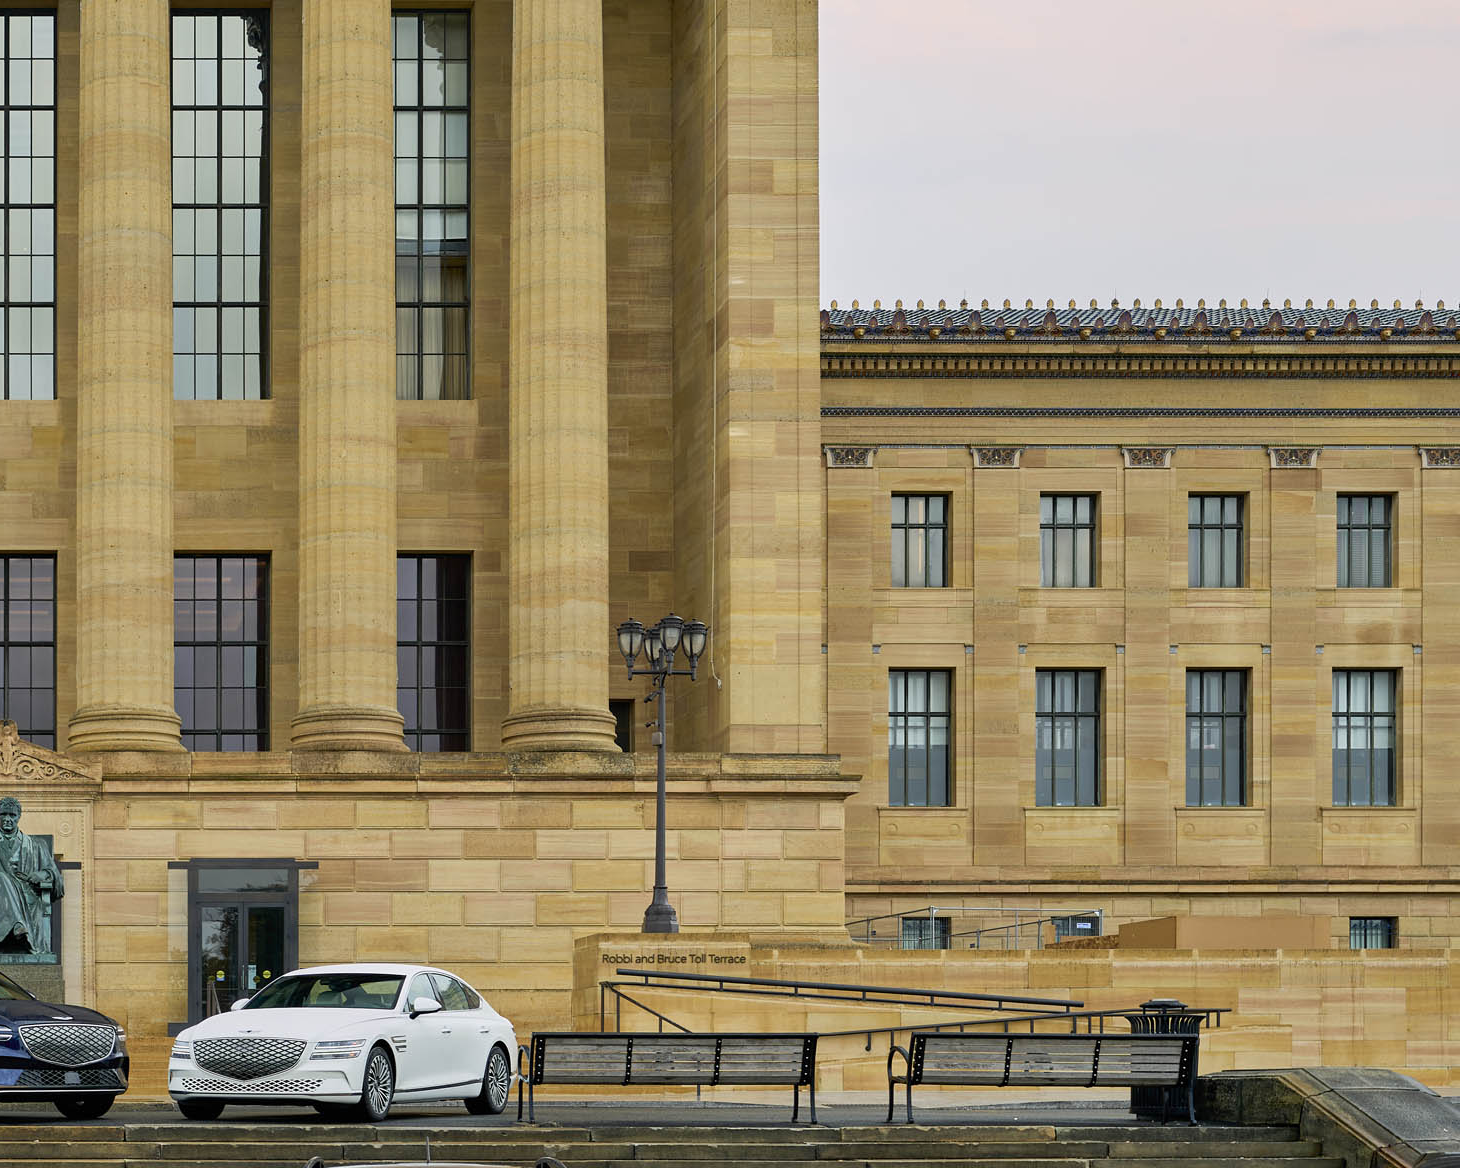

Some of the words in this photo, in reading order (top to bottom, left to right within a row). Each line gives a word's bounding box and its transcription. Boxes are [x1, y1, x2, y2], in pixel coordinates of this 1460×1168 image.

[602, 953, 633, 964] Robbi
[635, 953, 655, 964] and
[657, 953, 687, 964] Bruce
[689, 953, 707, 964] Toll
[708, 953, 746, 964] Terrace
